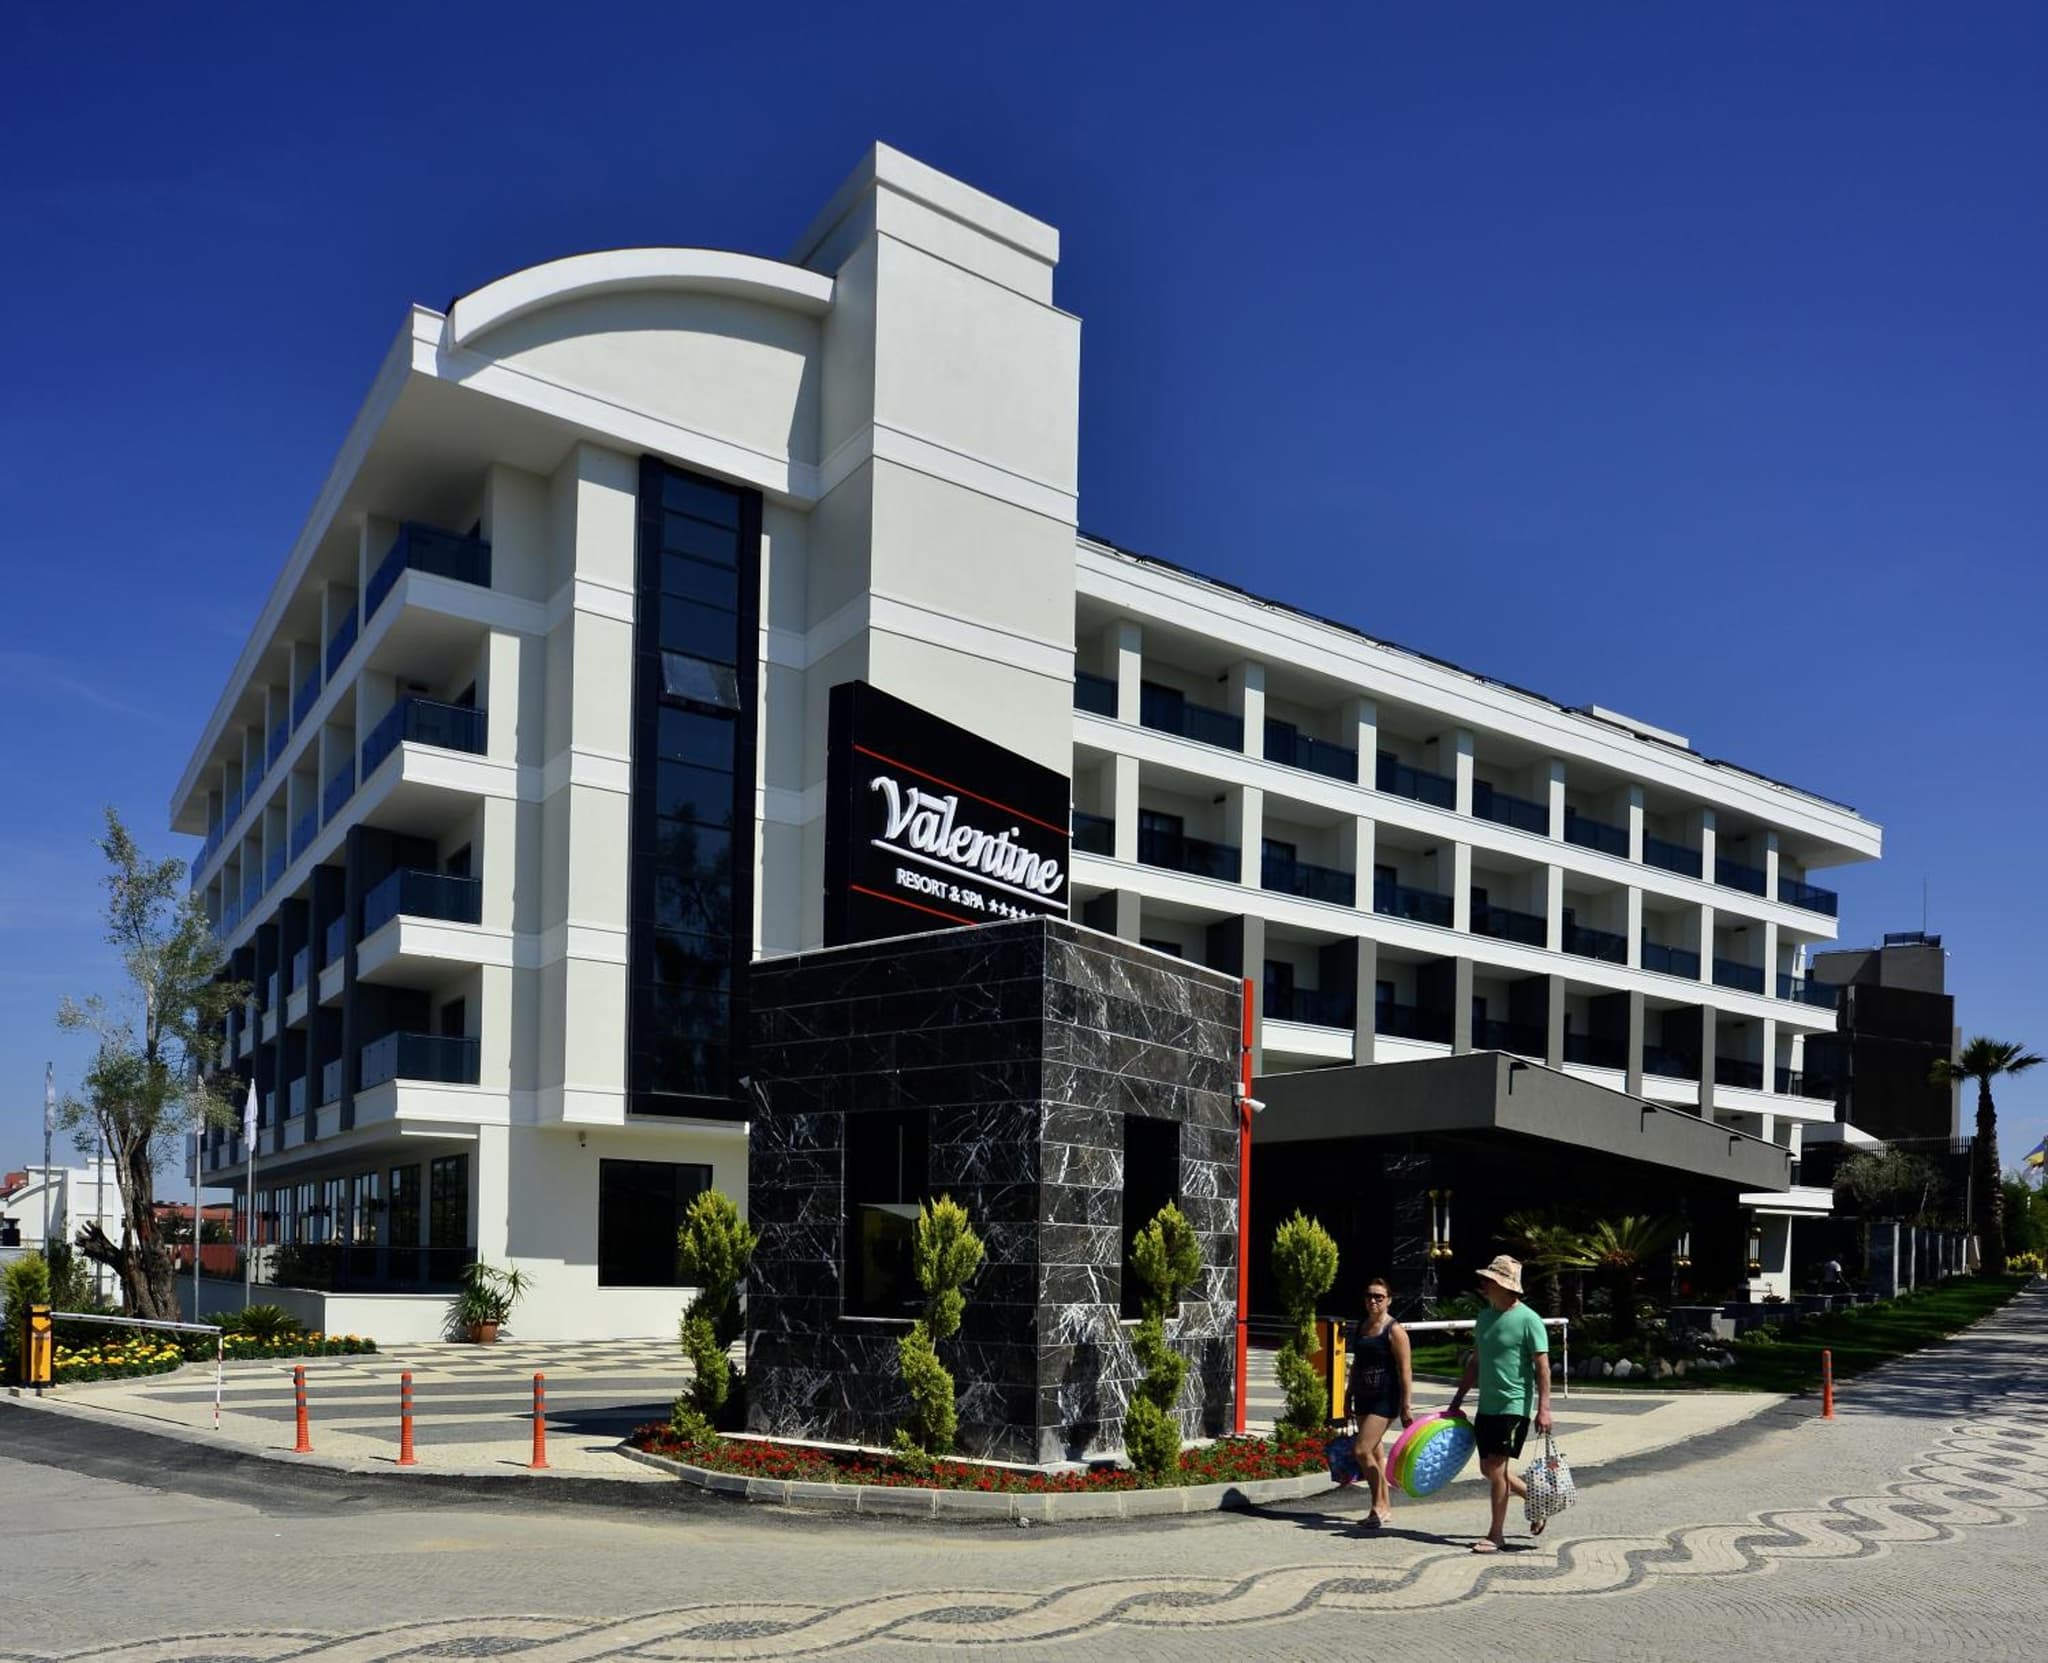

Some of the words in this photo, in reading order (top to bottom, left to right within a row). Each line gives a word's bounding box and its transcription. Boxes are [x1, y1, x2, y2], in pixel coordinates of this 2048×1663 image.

[870, 776, 1064, 894] Valentine
[896, 868, 949, 899] RESORT
[949, 885, 960, 903] &
[960, 889, 985, 911] SPA
